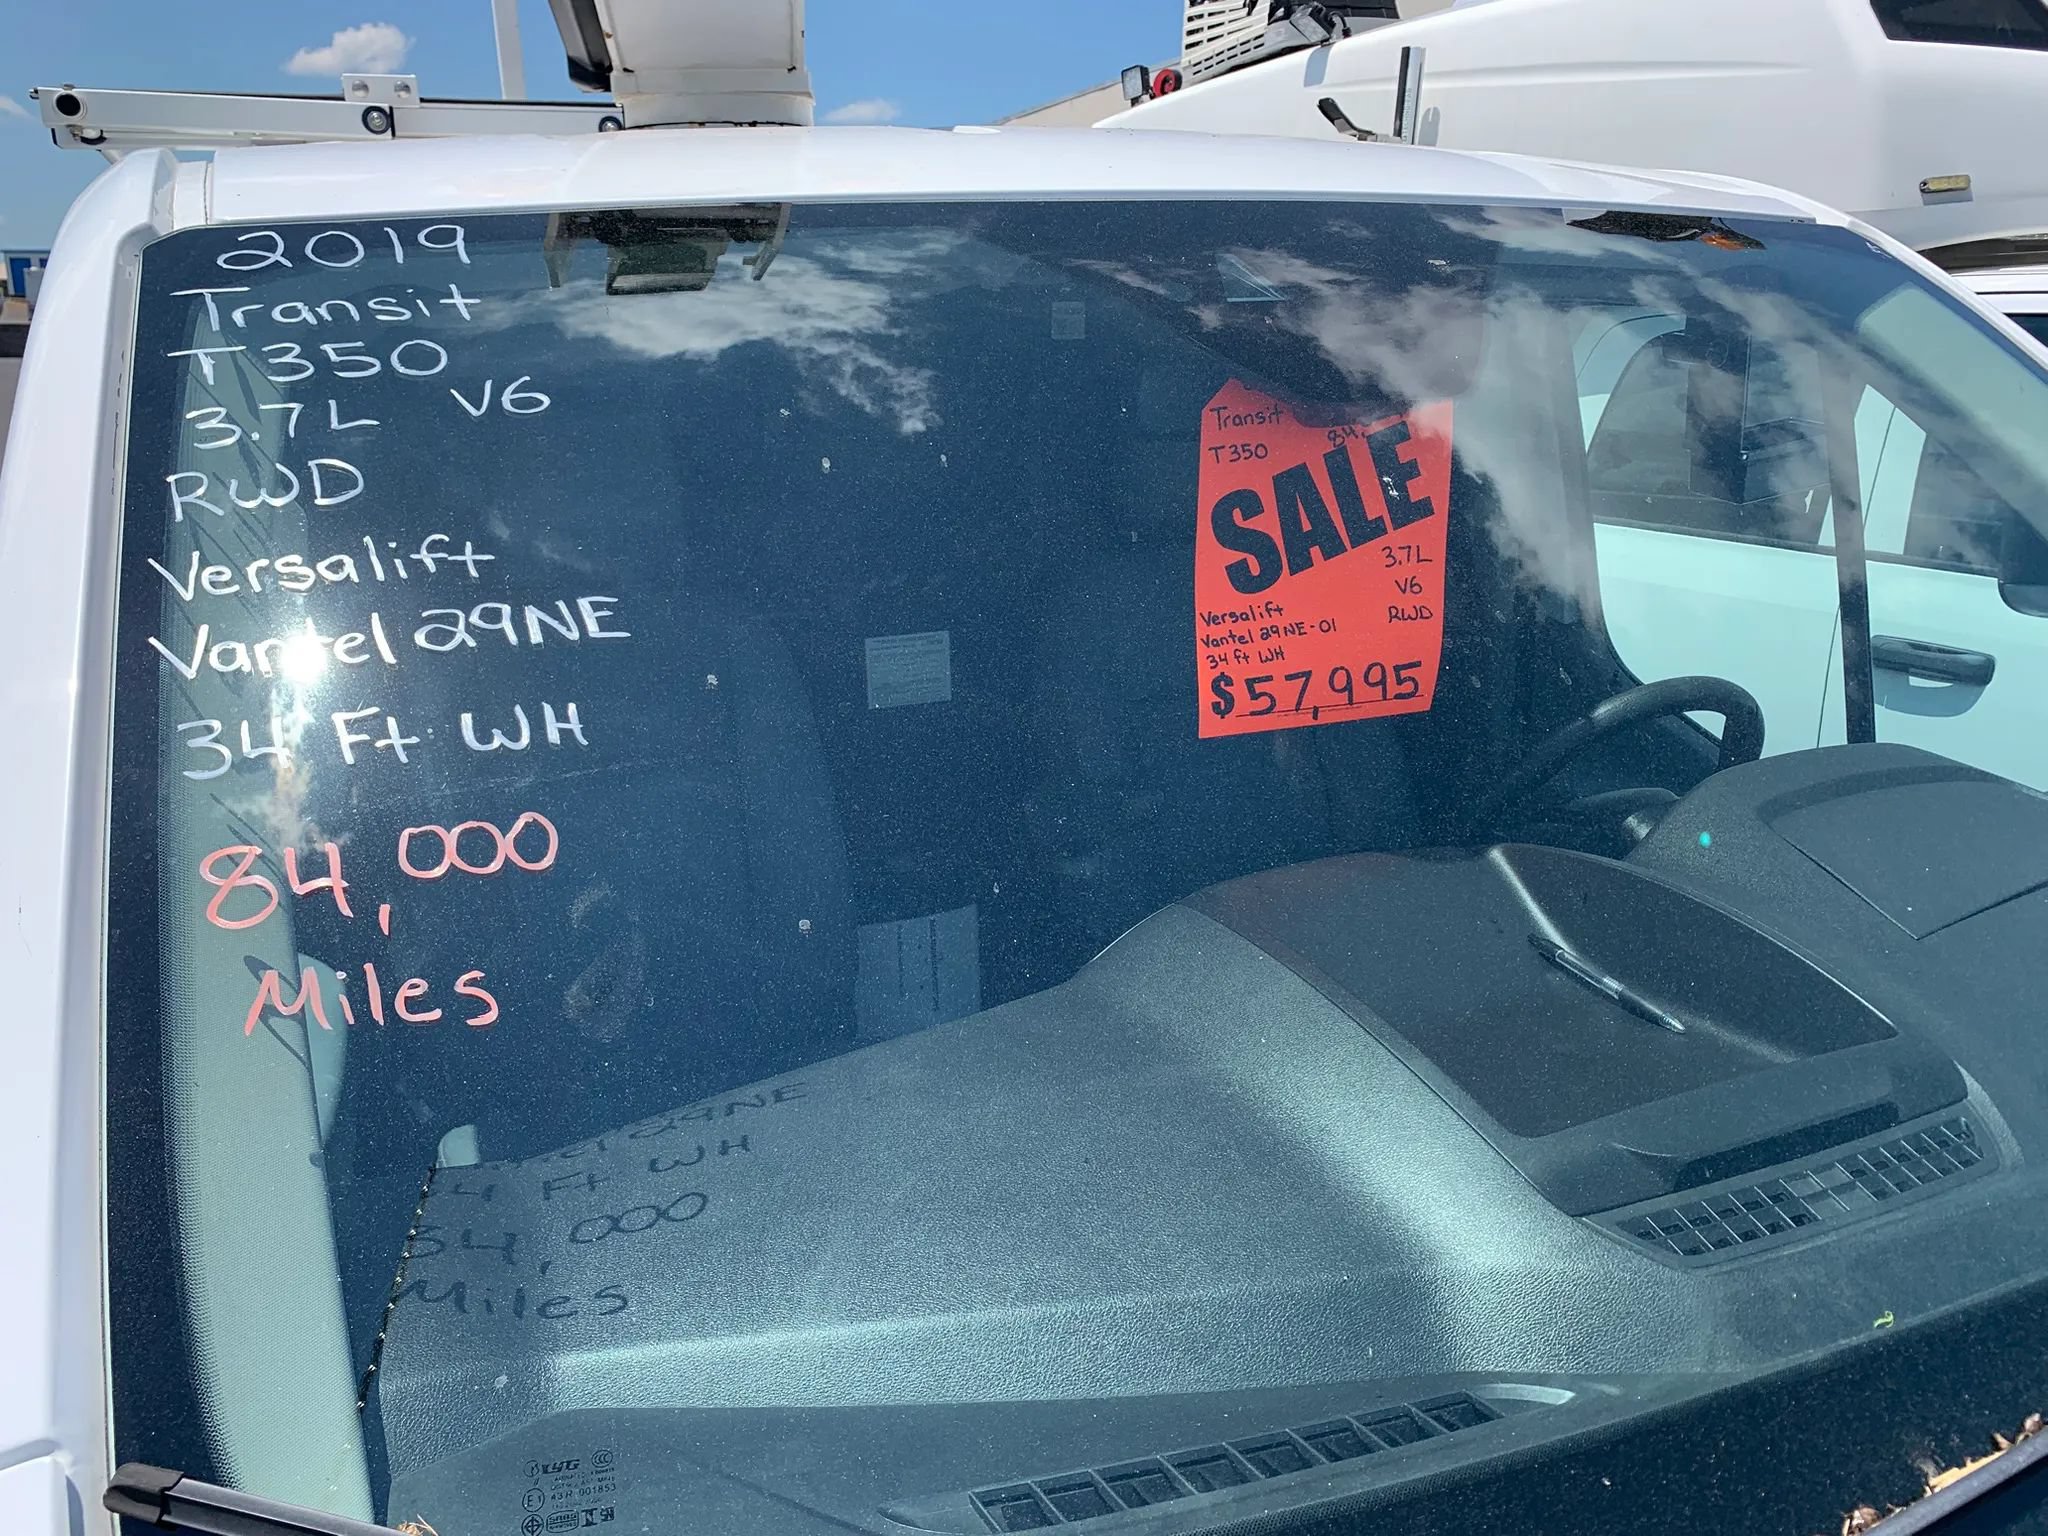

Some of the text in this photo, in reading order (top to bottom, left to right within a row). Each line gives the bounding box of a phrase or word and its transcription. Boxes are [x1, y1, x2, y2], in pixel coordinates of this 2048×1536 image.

[216, 224, 471, 273] 2019
[170, 283, 481, 331] Transit
[168, 339, 449, 386] T350
[186, 376, 551, 449] 3.7L V6
[1209, 403, 1283, 431] Transit
[1208, 442, 1269, 464] T350
[166, 458, 365, 522] RWD
[1210, 420, 1436, 595] SALE
[148, 534, 495, 602] Versalift
[1382, 545, 1433, 568] 3.7L
[1394, 575, 1424, 595] V6
[1199, 601, 1284, 627] Versalift
[1388, 605, 1434, 623] RWD
[147, 596, 632, 681] Vantel 29NE
[1200, 629, 1255, 649] Vantel
[1206, 645, 1285, 669] 34 ft WH
[1210, 660, 1424, 721] $57,995
[177, 719, 293, 780] 34
[461, 702, 590, 751] WH
[200, 811, 559, 936] 84,000
[244, 962, 500, 1037] Miles
